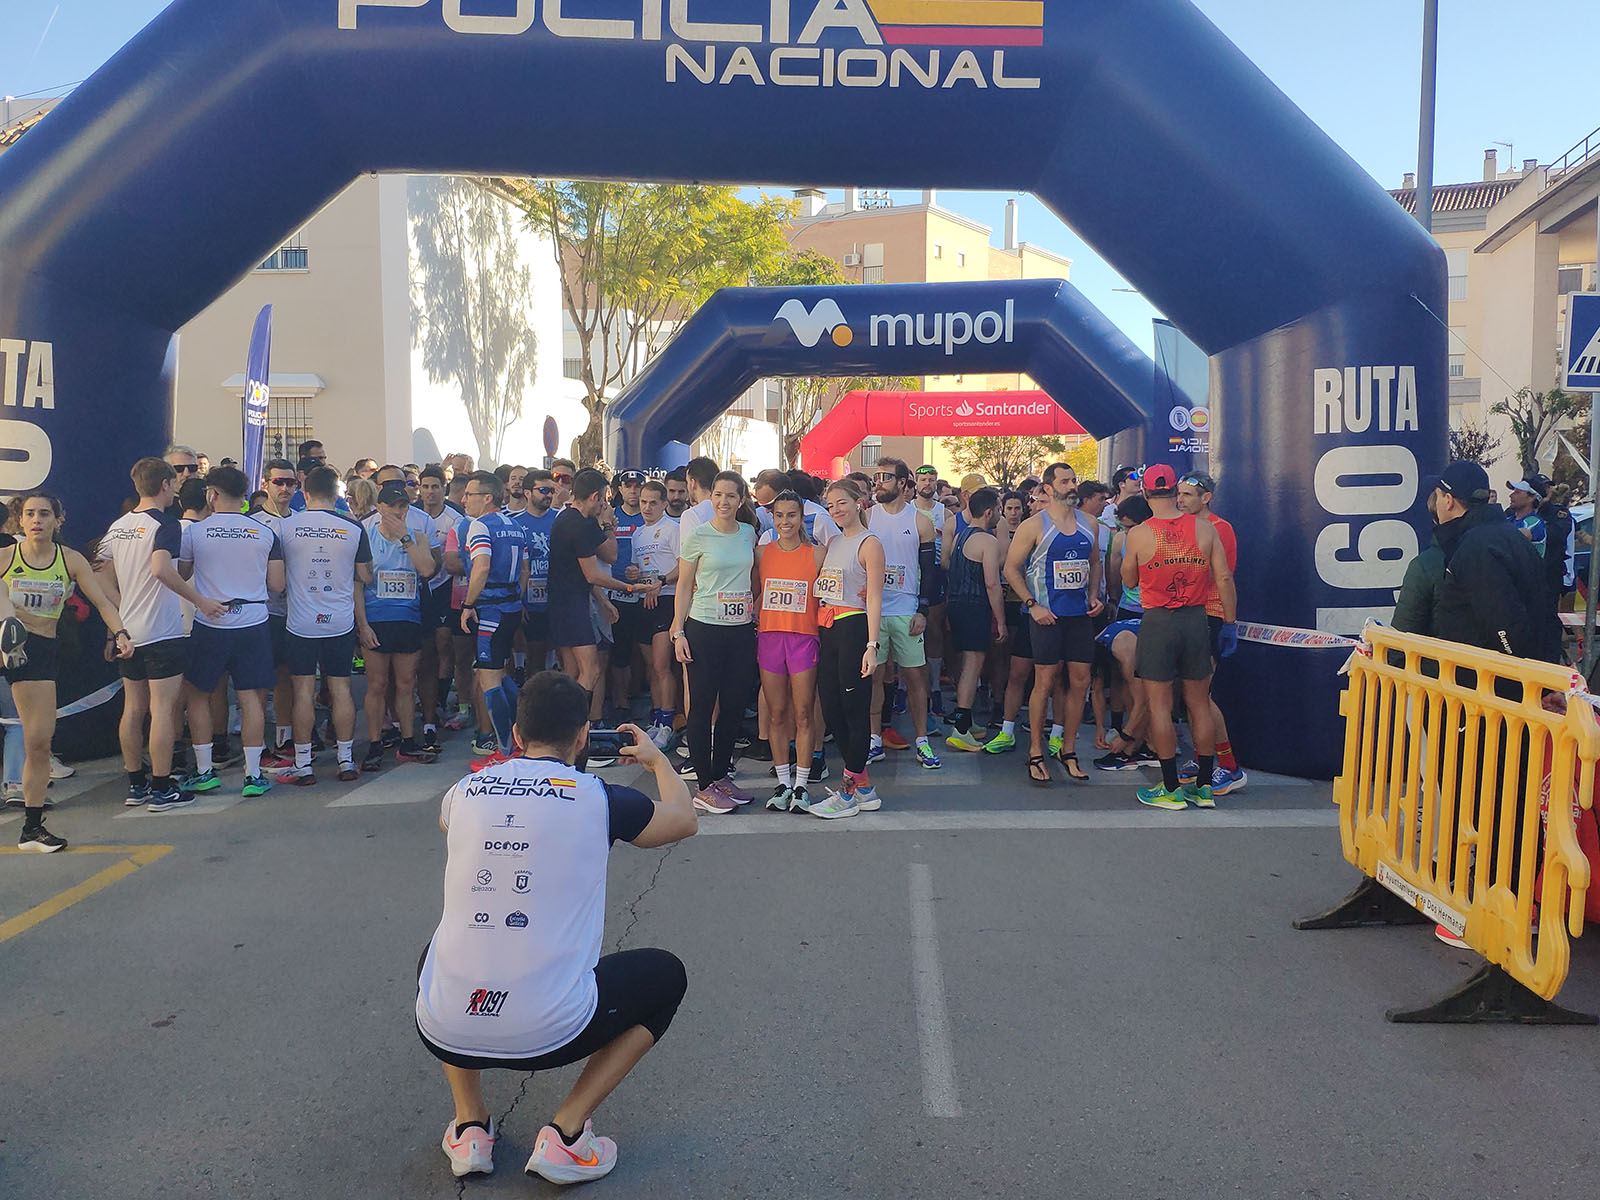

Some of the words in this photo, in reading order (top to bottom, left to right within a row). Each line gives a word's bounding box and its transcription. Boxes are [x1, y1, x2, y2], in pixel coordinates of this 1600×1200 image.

[665, 43, 1041, 89] NACIONAL
[869, 298, 1014, 355] mupol
[1313, 366, 1419, 434] RUTA
[908, 402, 953, 420] Sports
[975, 400, 1052, 416] Santander
[294, 532, 348, 540] NACIONAL
[295, 526, 337, 534] POLICIA
[1314, 445, 1419, 635] 091
[1058, 571, 1082, 584] 430
[383, 581, 405, 593] 133
[816, 578, 837, 593] 482
[23, 593, 43, 607] 111
[770, 591, 793, 605] 210
[723, 603, 744, 616] 136
[468, 775, 552, 787] POLICIA
[465, 785, 576, 801] NACIONAL
[1385, 871, 1420, 900] Ayuntamient
[1426, 899, 1438, 914] Dos
